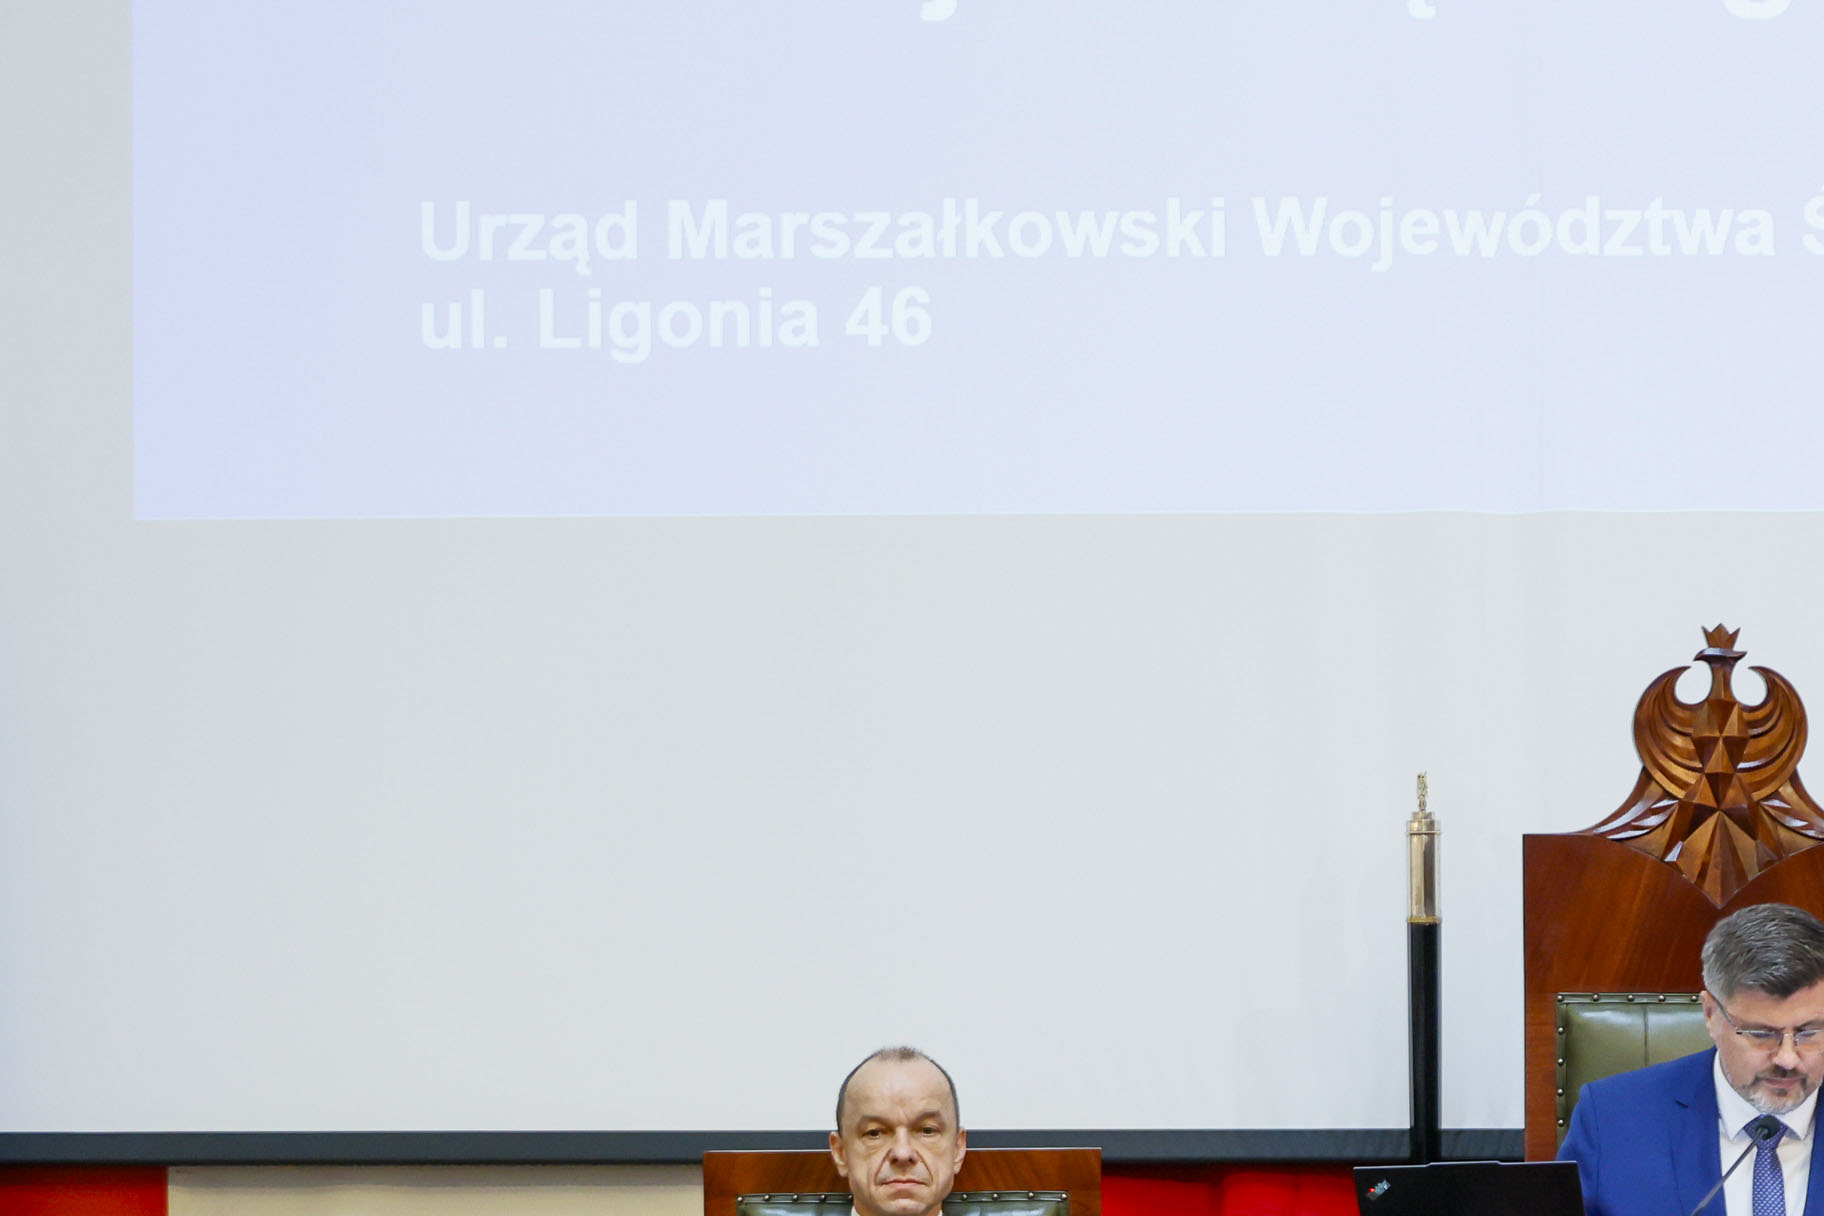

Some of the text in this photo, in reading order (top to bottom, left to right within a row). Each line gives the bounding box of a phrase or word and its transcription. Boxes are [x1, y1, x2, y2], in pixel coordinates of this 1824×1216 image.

[421, 200, 638, 274] Urząd
[668, 197, 1226, 259] Marszałkowski
[1252, 194, 1775, 272] Województwa
[421, 286, 932, 363] ul. Ligonia 46
